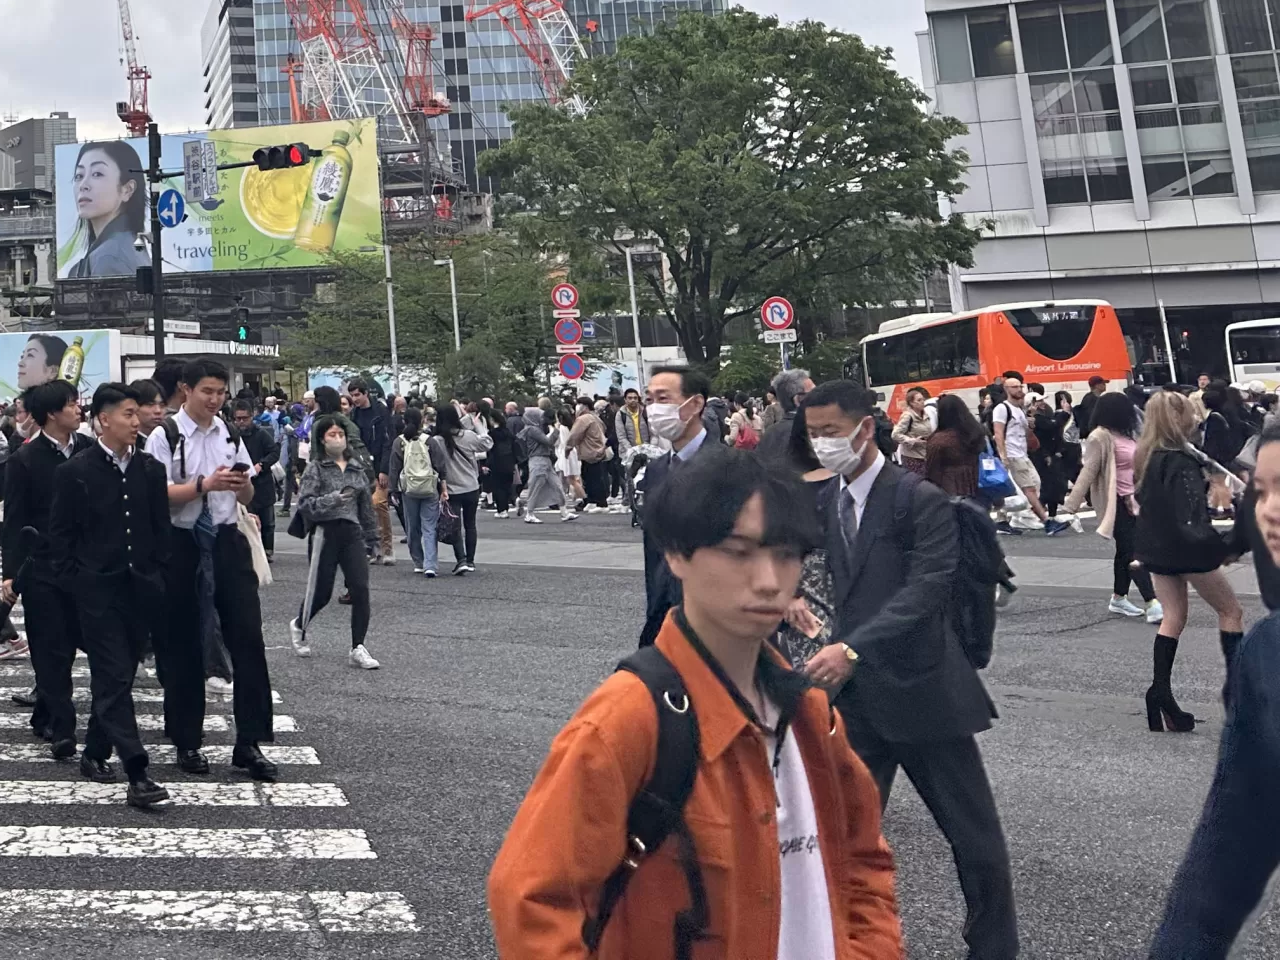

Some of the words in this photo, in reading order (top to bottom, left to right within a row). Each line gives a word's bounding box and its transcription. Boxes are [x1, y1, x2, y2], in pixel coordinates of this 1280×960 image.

[191, 146, 201, 197] 渋谷駅前
[199, 213, 225, 221] meets
[187, 226, 237, 236] 宇多田ヒカル
[766, 332, 795, 341] ここまで
[1025, 364, 1055, 373] Airport
[1058, 361, 1101, 371] Limousine
